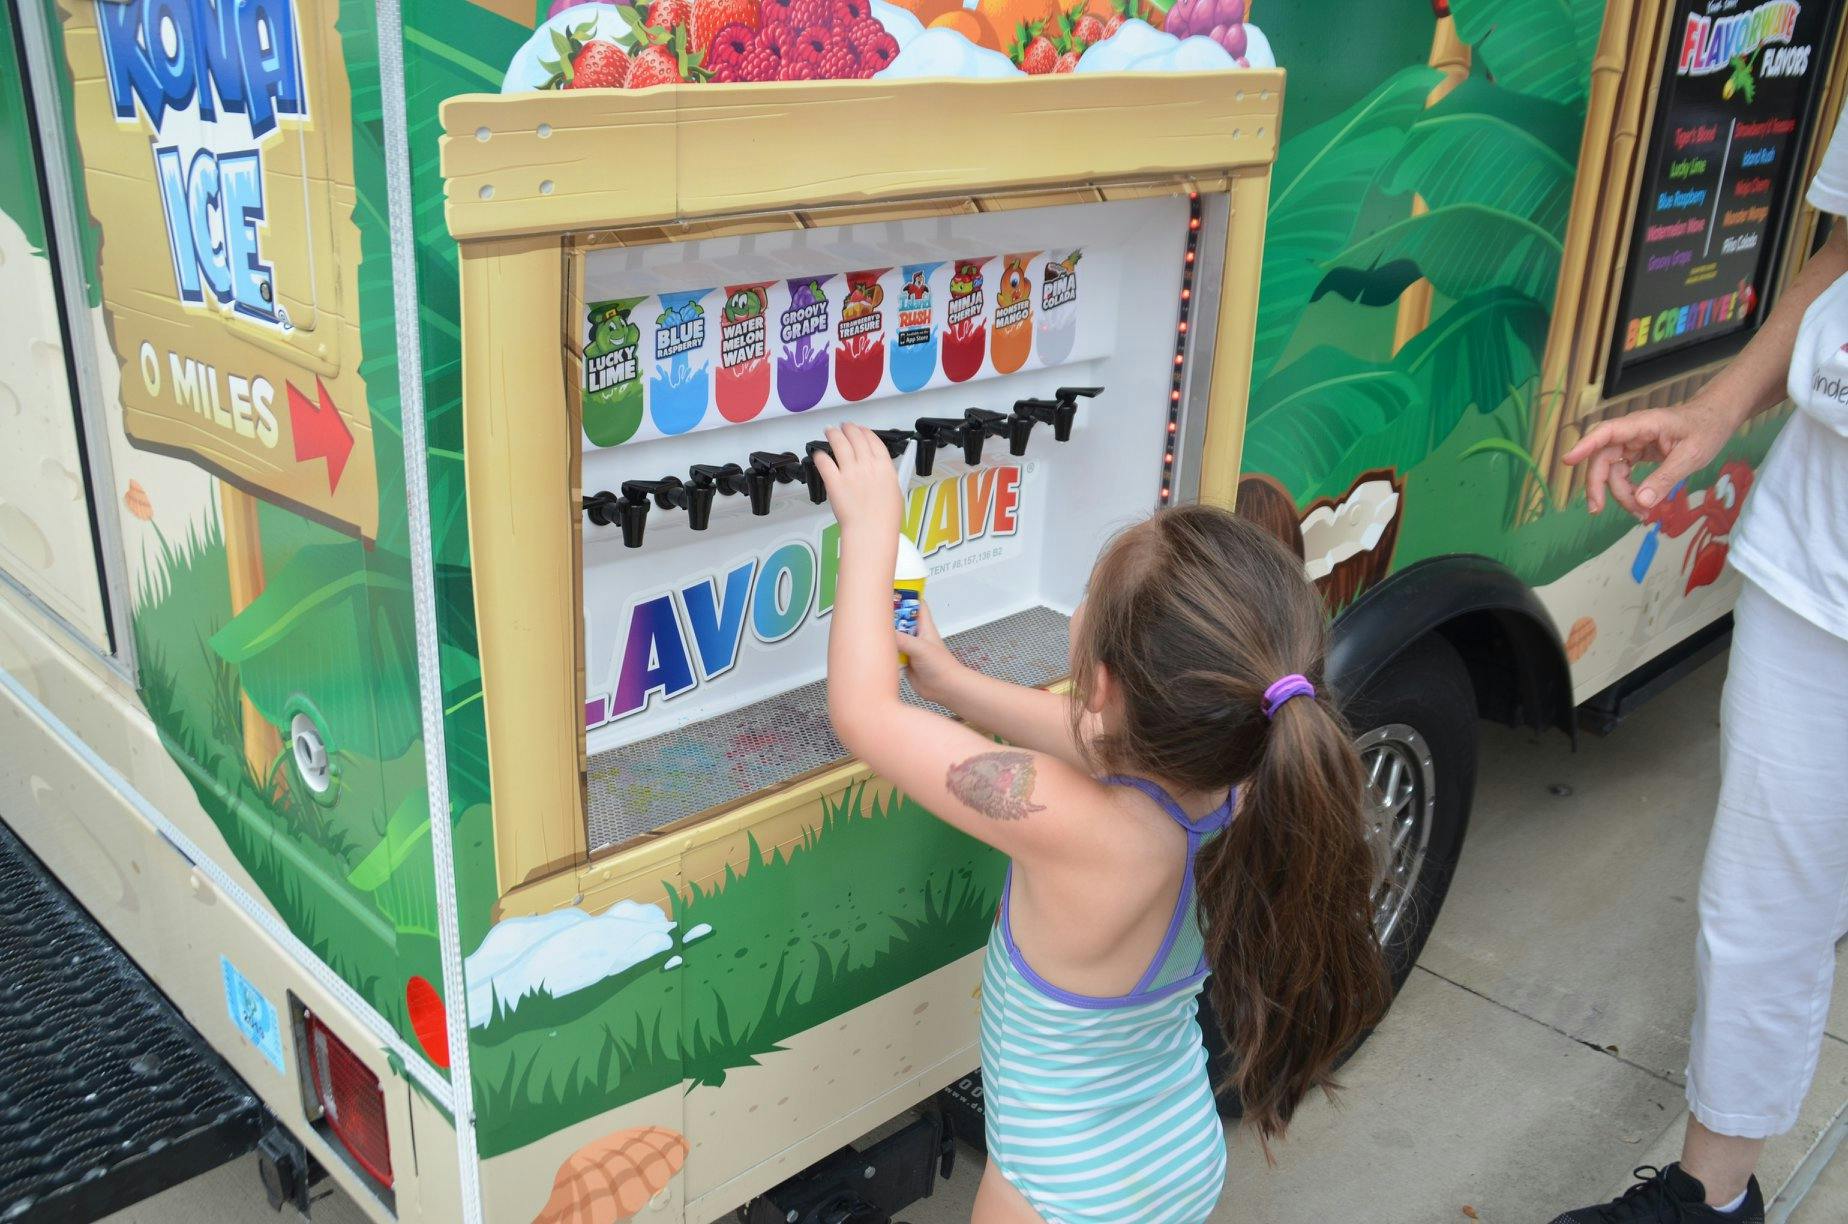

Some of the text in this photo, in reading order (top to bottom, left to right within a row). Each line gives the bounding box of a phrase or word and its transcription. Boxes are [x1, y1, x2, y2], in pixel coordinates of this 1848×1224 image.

[98, 0, 309, 138] KONA
[1760, 45, 1811, 77] FLAVORS
[156, 146, 276, 325] ICE
[949, 291, 982, 313] NINJA
[996, 301, 1029, 319] MONSTER
[1042, 289, 1076, 310] COLADA
[782, 301, 827, 325] GROOVY
[899, 309, 931, 327] RUSH
[949, 304, 982, 325] CHERRY
[996, 310, 1029, 329] MANGO
[657, 318, 704, 349] BLUE
[723, 316, 764, 338] WATER
[782, 315, 827, 342] GRAPE
[840, 320, 880, 339] TREASURE
[1624, 315, 1652, 352] BE
[657, 338, 703, 359] RASPBERRY
[723, 330, 764, 352] MELON
[906, 335, 916, 344] App
[588, 346, 636, 372] LUCKY
[723, 342, 764, 368] WAVE
[588, 361, 636, 393] LIME
[169, 352, 279, 448] MILES
[928, 560, 951, 577] TENT
